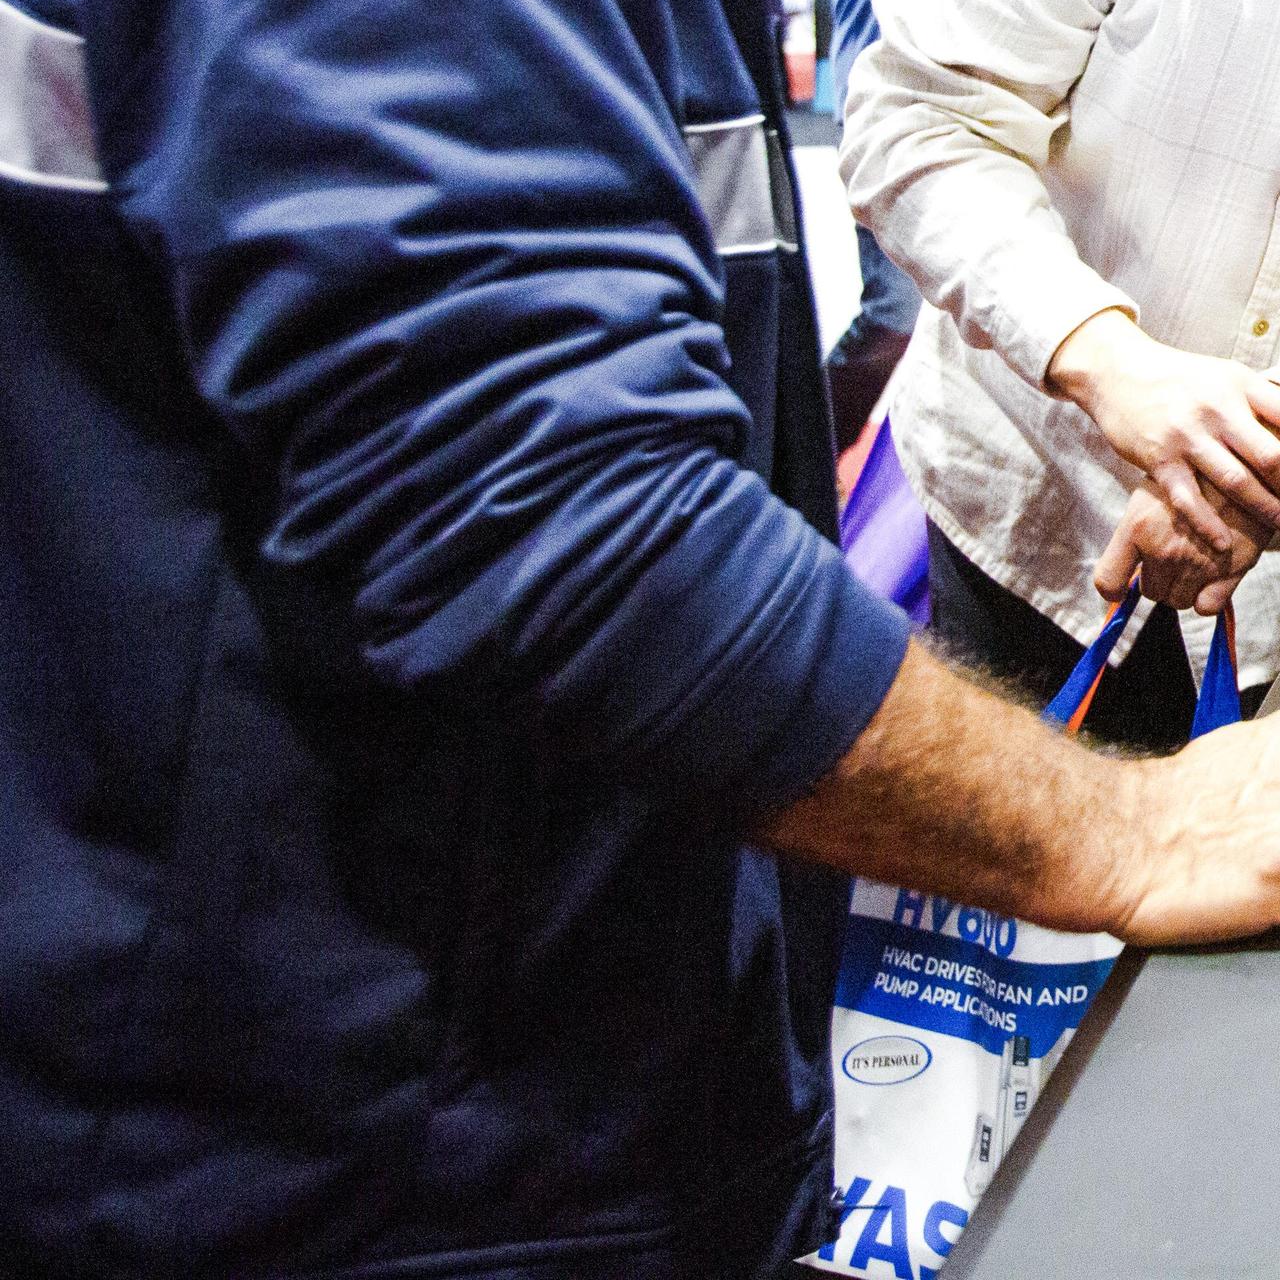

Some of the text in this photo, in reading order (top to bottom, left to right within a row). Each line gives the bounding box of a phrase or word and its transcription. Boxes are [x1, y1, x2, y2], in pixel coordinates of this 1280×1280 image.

[874, 972, 919, 999] PUMP
[881, 945, 922, 973] HVAC
[924, 957, 983, 988] DRIVES
[996, 982, 1033, 1007] FAN
[1035, 984, 1089, 1008] AND
[872, 1053, 920, 1068] PERSONAL
[817, 1175, 970, 1280] YAS
